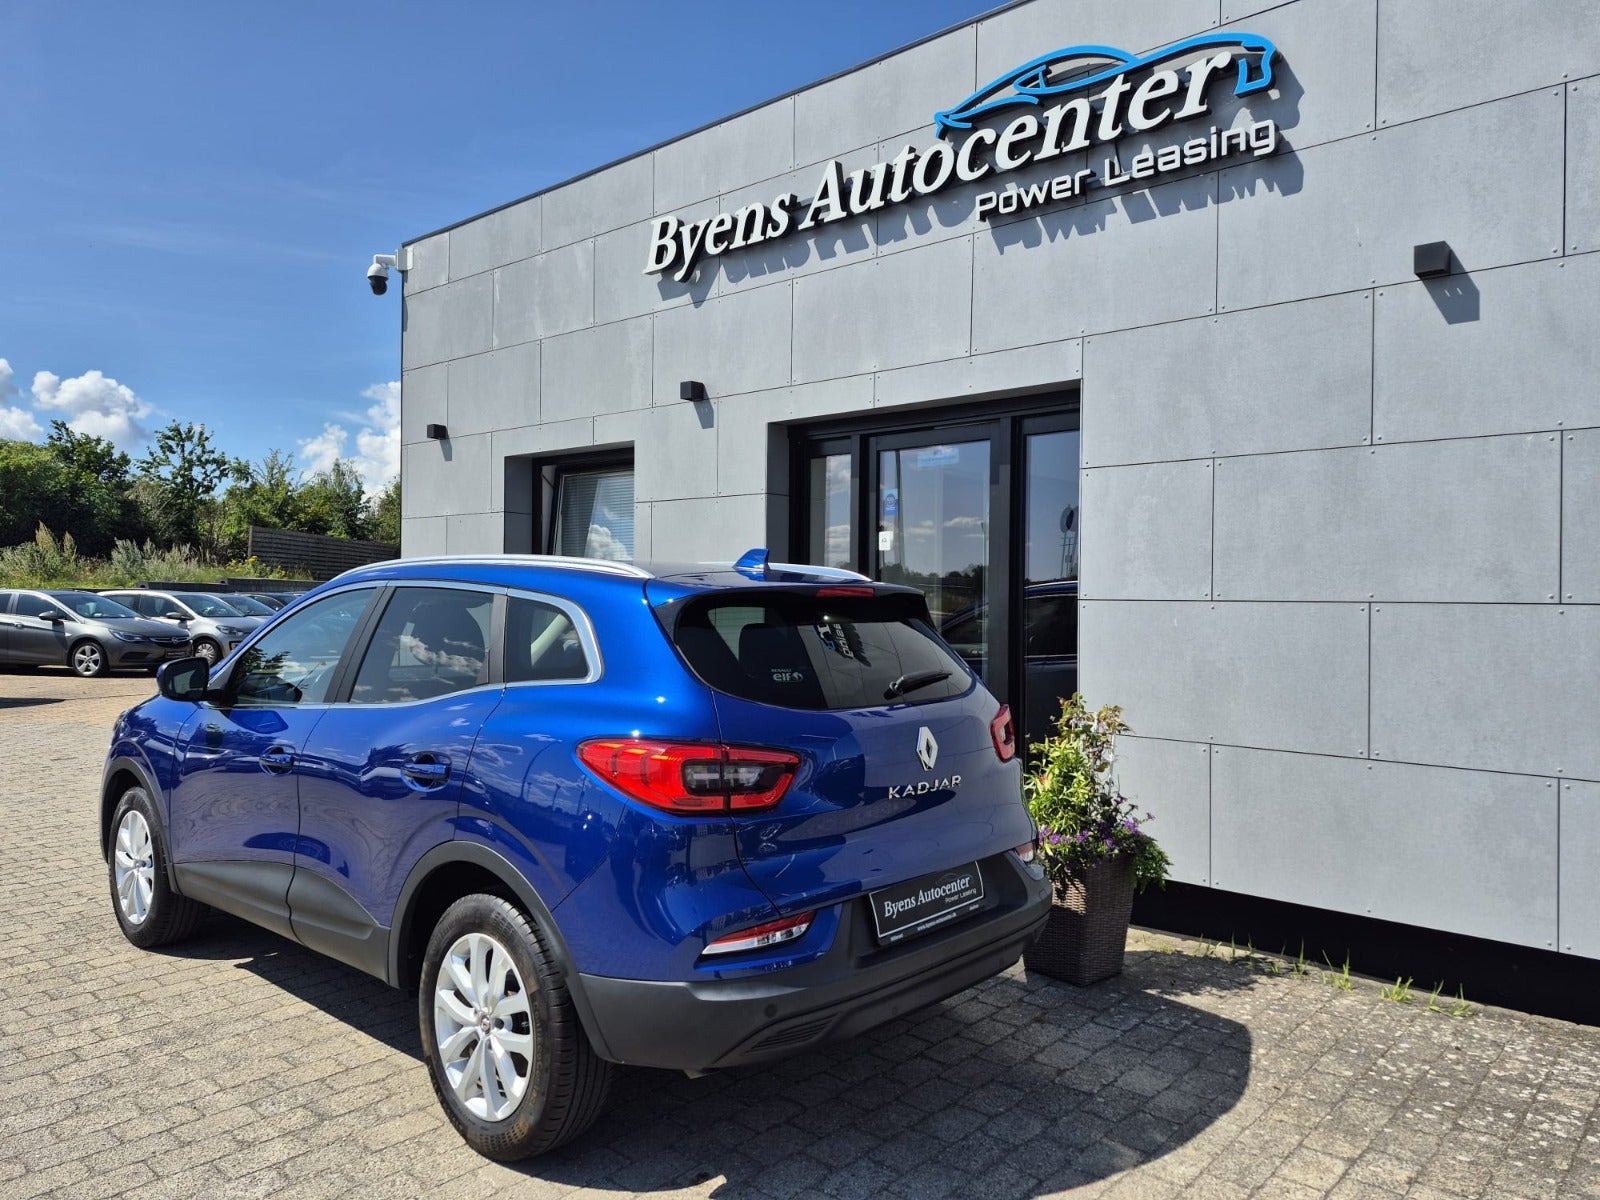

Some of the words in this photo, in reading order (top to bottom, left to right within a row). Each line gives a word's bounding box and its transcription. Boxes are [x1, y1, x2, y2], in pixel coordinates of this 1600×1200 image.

[642, 192, 796, 283] Byens
[798, 51, 1233, 230] Autocenter
[975, 168, 1093, 221] Power
[1104, 119, 1277, 187] Leasing
[772, 672, 792, 681] elf
[888, 775, 962, 800] KADJAR
[884, 895, 917, 919] Byens
[917, 877, 970, 905] Autocenter
